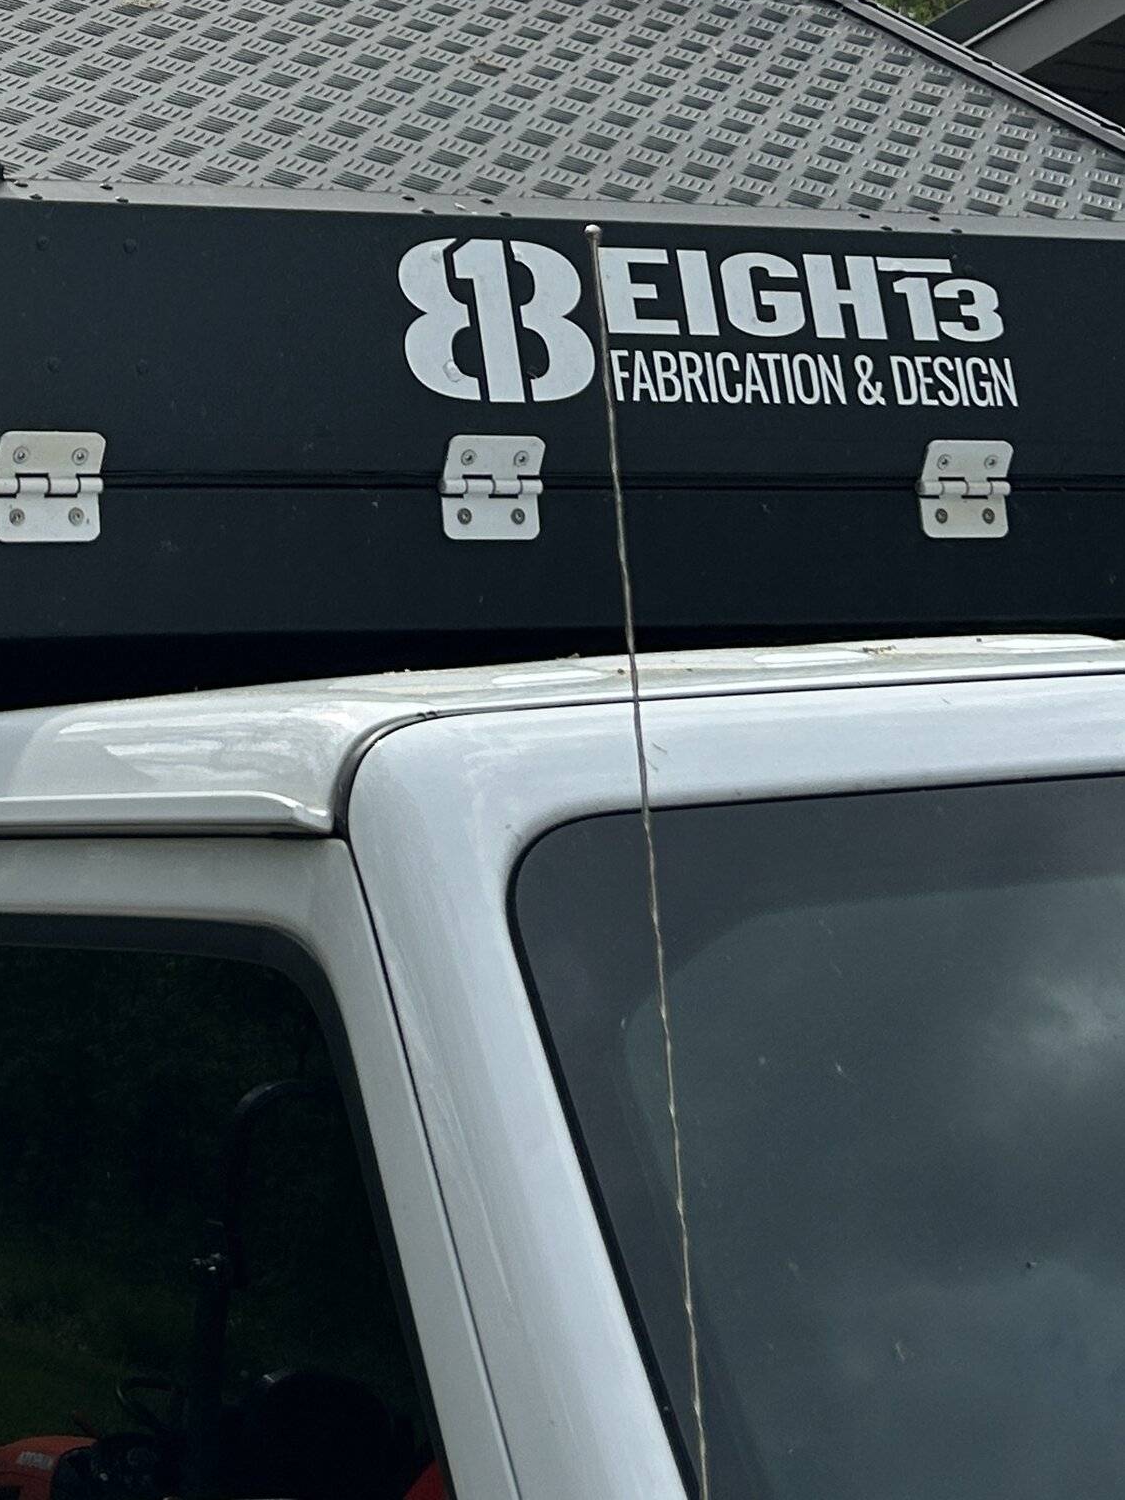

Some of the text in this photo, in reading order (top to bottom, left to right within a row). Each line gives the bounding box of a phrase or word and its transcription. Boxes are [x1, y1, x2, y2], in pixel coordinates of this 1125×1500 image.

[610, 349, 1019, 407] FABRICATION & DESIGN
